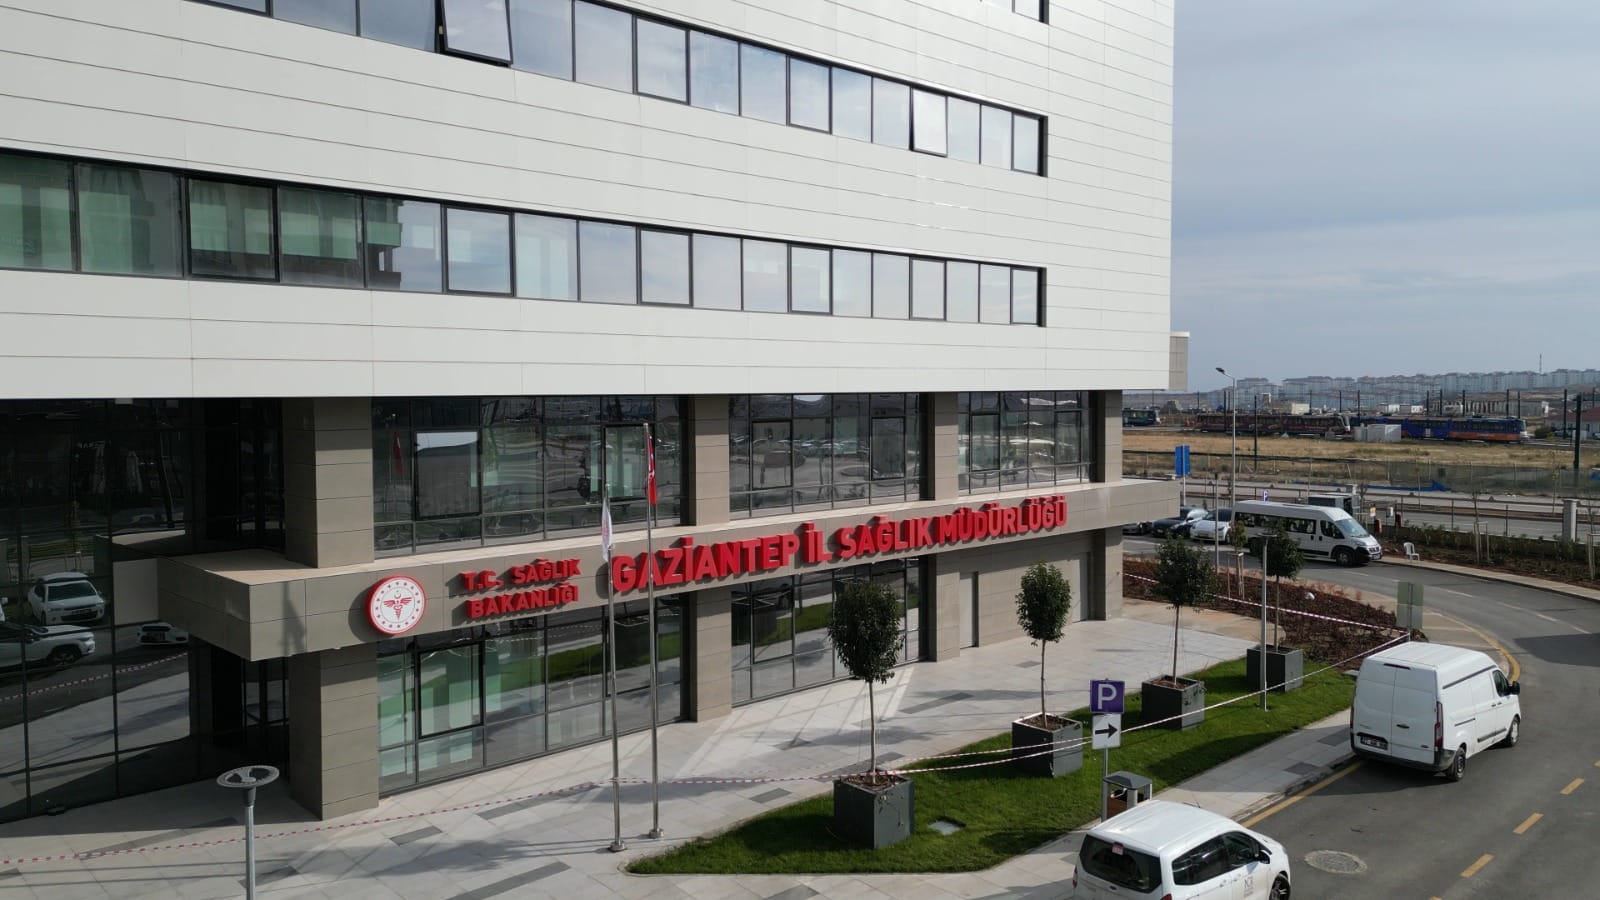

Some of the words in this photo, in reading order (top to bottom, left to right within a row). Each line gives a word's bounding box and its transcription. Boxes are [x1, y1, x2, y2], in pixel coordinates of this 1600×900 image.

[612, 536, 800, 592] GAZİANTEP
[801, 523, 832, 563] İL
[836, 514, 934, 559] SAĞLIK
[936, 496, 1068, 545] MÜDÜRLÜĞÜ
[461, 570, 504, 591] T.C.
[511, 557, 582, 585] SAĞLIK
[467, 582, 579, 618] BAKANLIĞI
[1097, 683, 1117, 710] P
